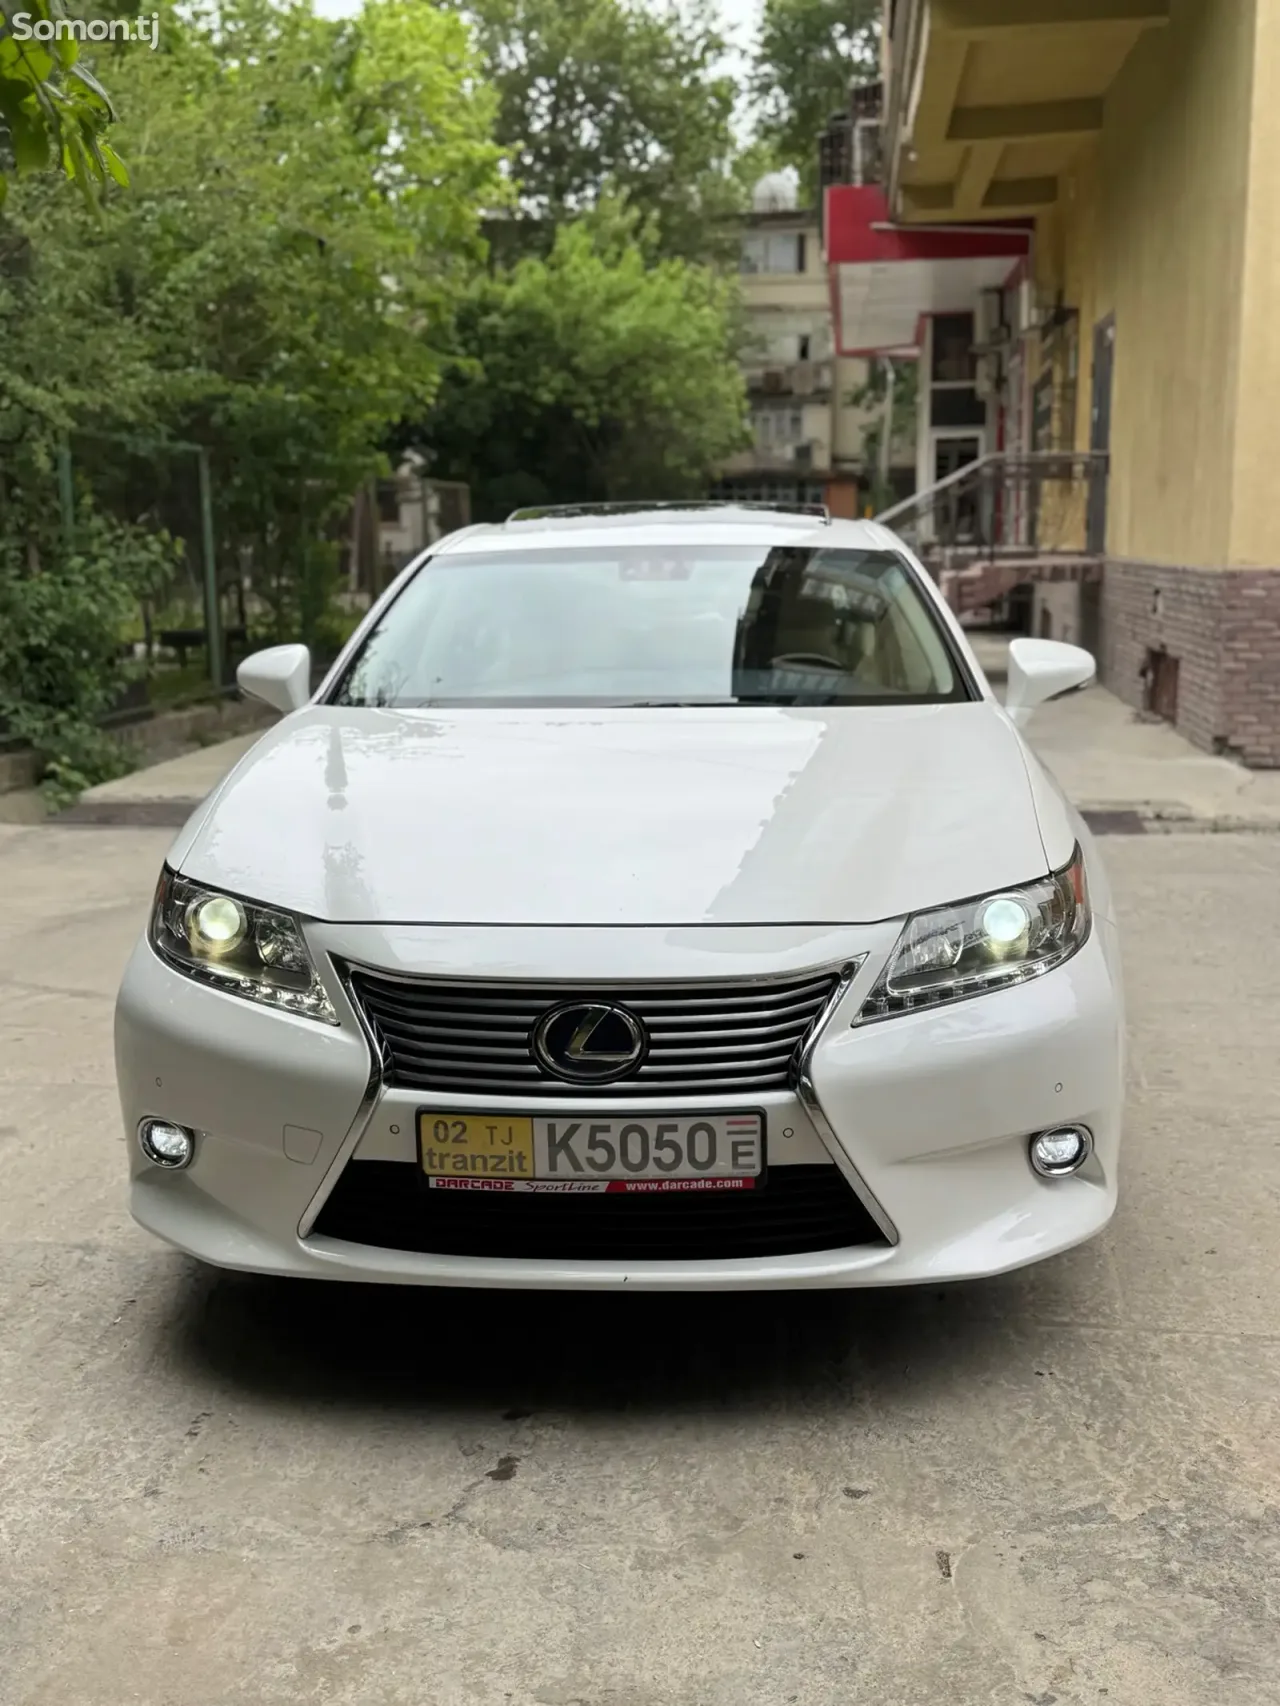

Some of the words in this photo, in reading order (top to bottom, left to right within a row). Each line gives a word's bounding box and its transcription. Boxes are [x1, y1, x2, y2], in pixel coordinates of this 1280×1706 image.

[433, 1120, 468, 1144] 02
[485, 1126, 513, 1145] TJ
[547, 1121, 717, 1173] K5050
[731, 1140, 755, 1170] E
[426, 1147, 528, 1173] tranzit
[435, 1178, 514, 1191] DARCADE
[625, 1178, 744, 1191] www.darcade.com
